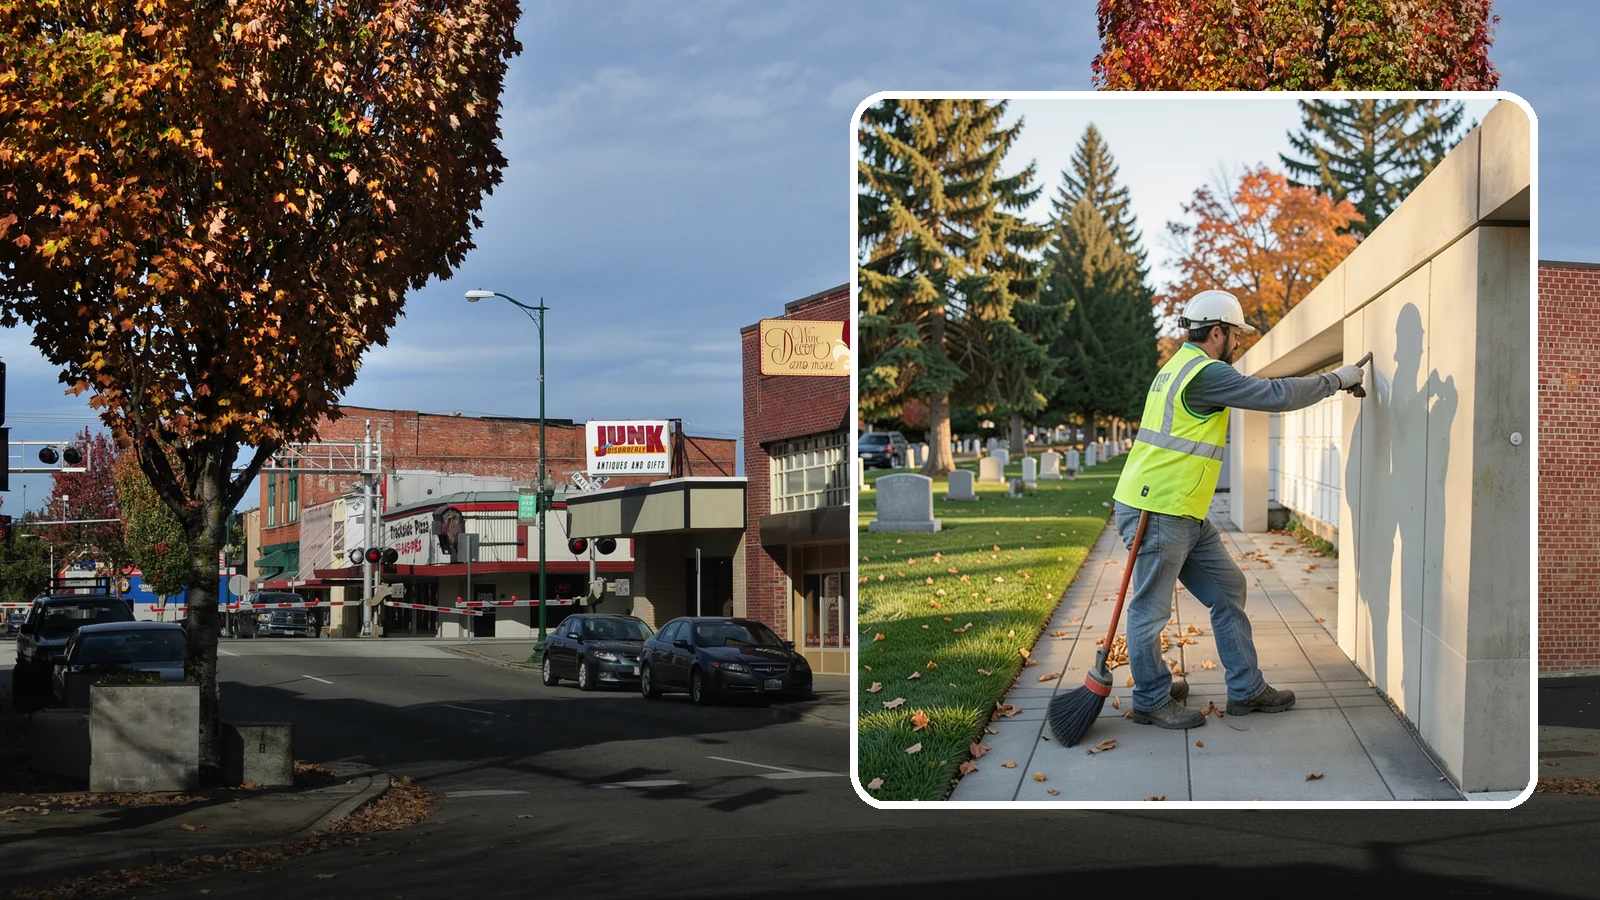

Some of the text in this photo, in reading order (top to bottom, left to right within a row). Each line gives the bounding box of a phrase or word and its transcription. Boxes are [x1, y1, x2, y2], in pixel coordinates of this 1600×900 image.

[765, 327, 831, 366] Decor
[595, 425, 665, 457] JUNK
[607, 446, 646, 454] DISORDERLY
[597, 460, 665, 470] ANTIQUES AND GIFTS
